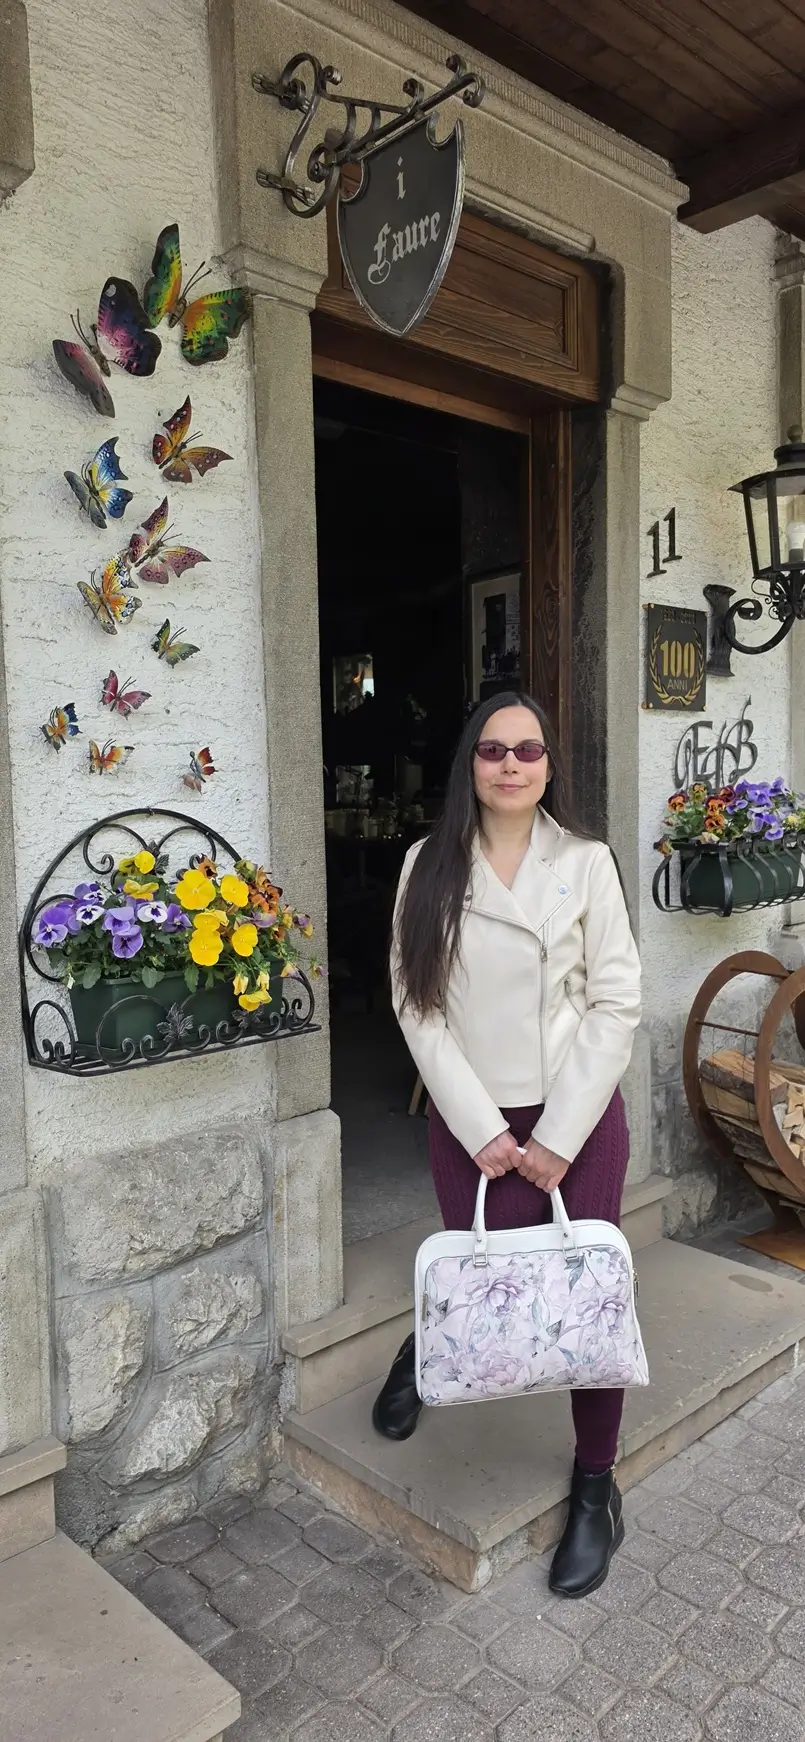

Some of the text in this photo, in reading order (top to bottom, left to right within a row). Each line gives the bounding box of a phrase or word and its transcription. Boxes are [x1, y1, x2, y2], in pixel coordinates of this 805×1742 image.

[396, 156, 406, 200] i
[367, 211, 441, 285] Faure
[646, 506, 683, 579] 11
[659, 639, 695, 679] 100
[666, 678, 688, 692] ANNI
